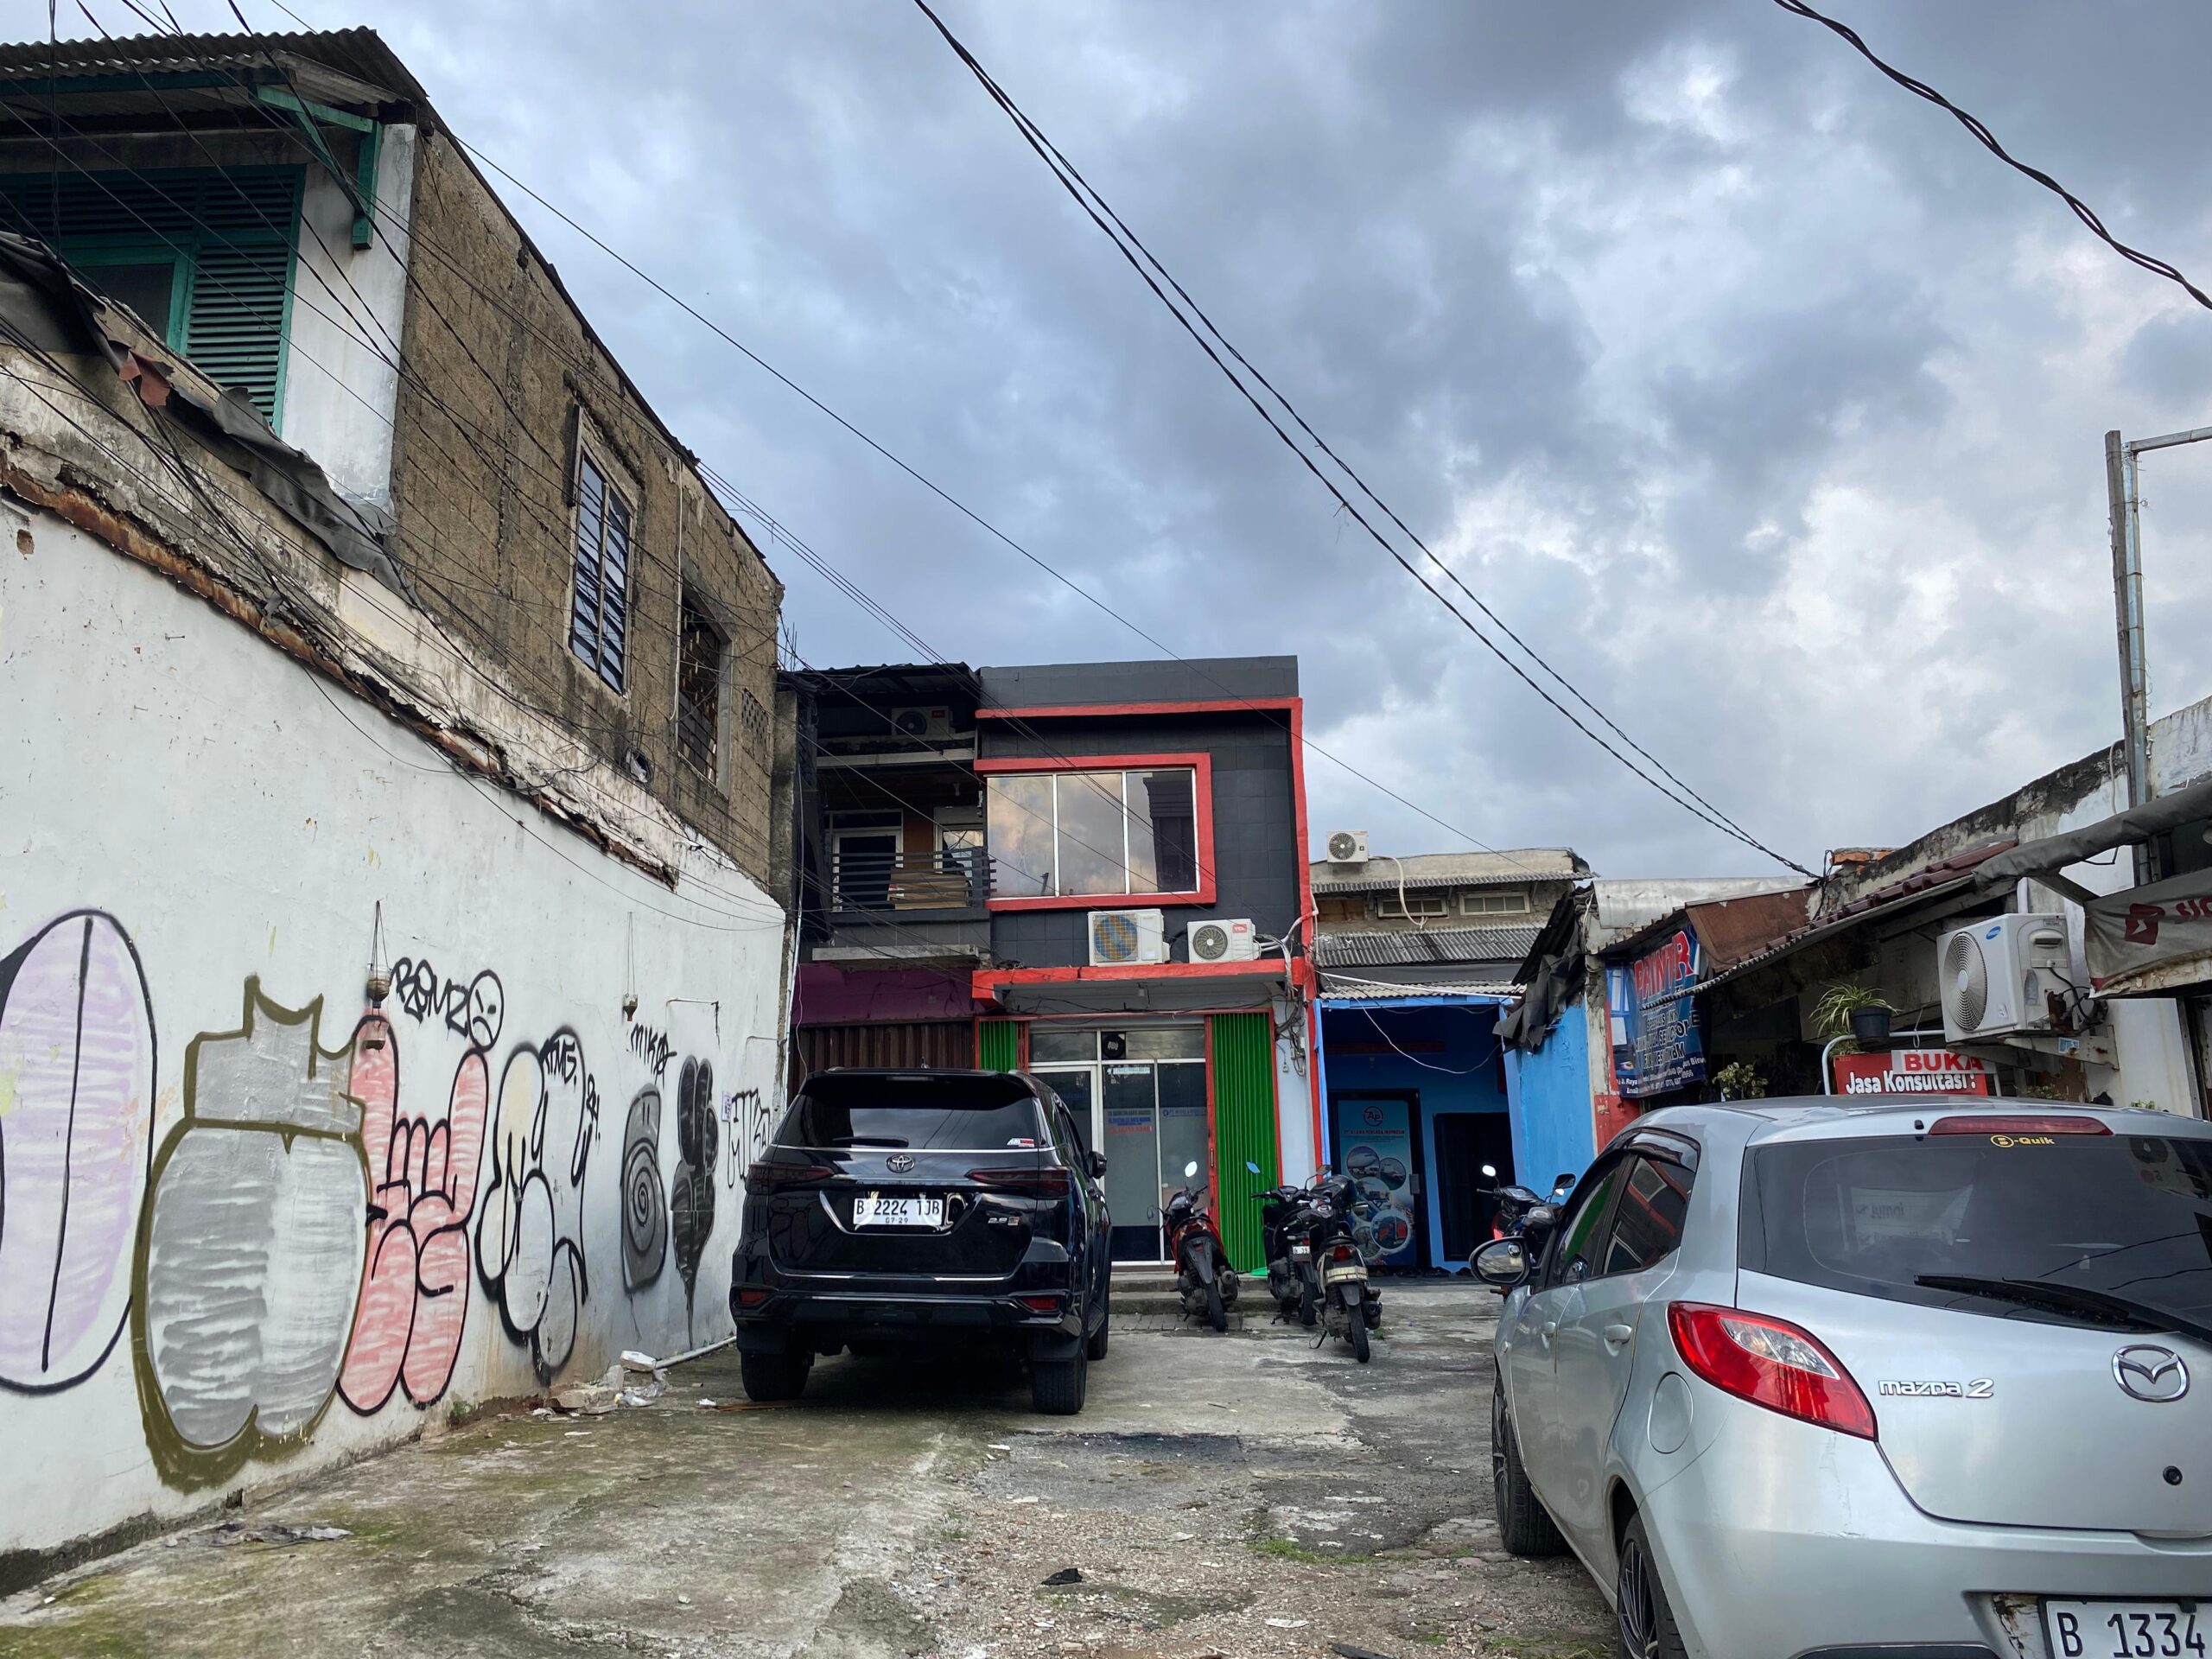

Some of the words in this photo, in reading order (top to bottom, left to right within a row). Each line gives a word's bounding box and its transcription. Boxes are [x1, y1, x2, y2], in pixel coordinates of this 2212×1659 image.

[1904, 1053, 1985, 1071] BUKA
[1846, 1071, 1882, 1095] Jasa
[856, 1201, 864, 1215] B
[874, 1200, 908, 1216] 2224
[1966, 1378, 1994, 1398] 2
[2056, 1612, 2083, 1657] B
[2107, 1612, 2206, 1659] 1334
